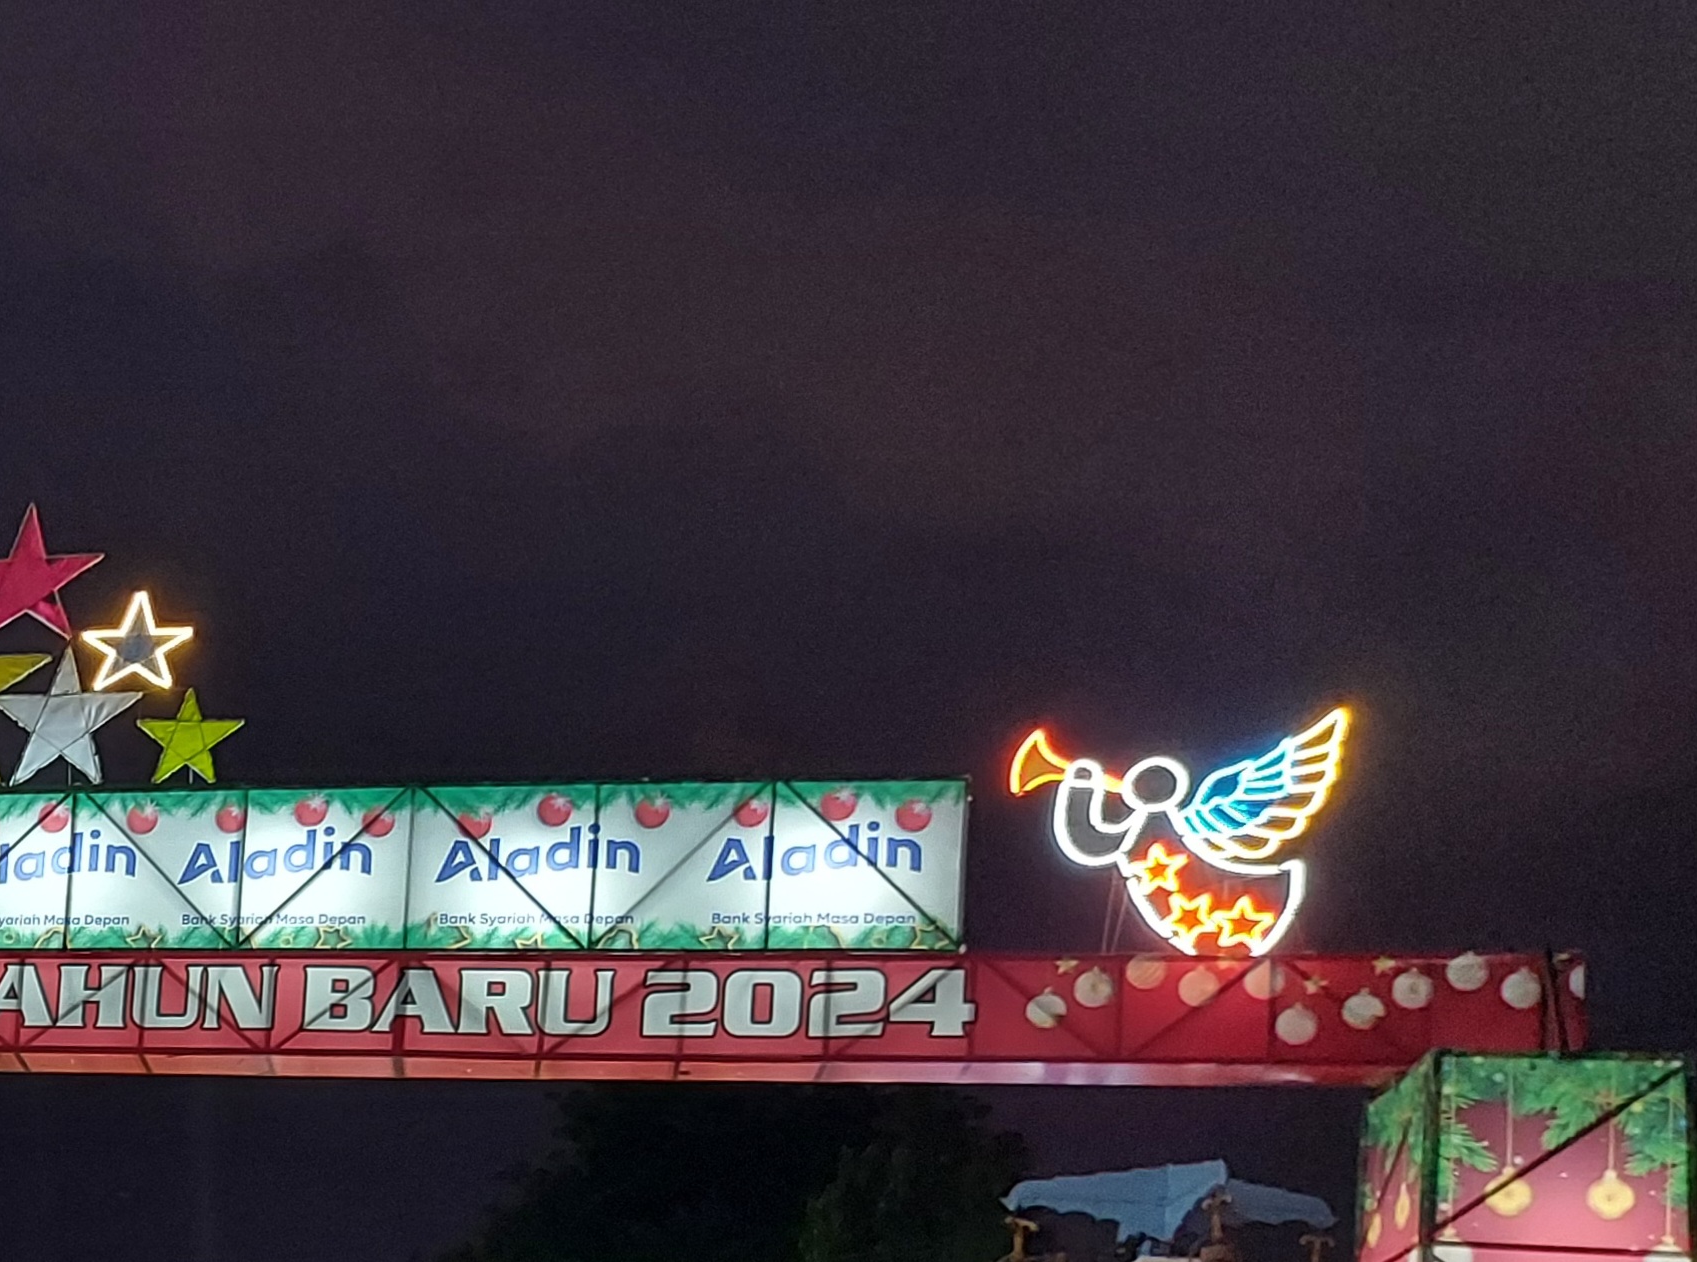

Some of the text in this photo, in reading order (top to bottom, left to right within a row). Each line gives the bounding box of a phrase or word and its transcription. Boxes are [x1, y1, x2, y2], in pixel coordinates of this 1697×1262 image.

[177, 825, 372, 885] Aladin
[435, 823, 642, 883] Aladin
[706, 821, 922, 882] Aladin
[84, 915, 129, 927] Depan
[182, 913, 215, 925] Bank
[276, 914, 313, 924] Masa
[319, 914, 365, 926] Depan
[439, 913, 633, 926] Bank Syariah Masa Depan
[712, 913, 750, 924] Bank
[817, 913, 858, 924] Masa
[864, 913, 915, 926] Depan
[302, 965, 615, 1037] BARU
[640, 967, 977, 1038] 2024
